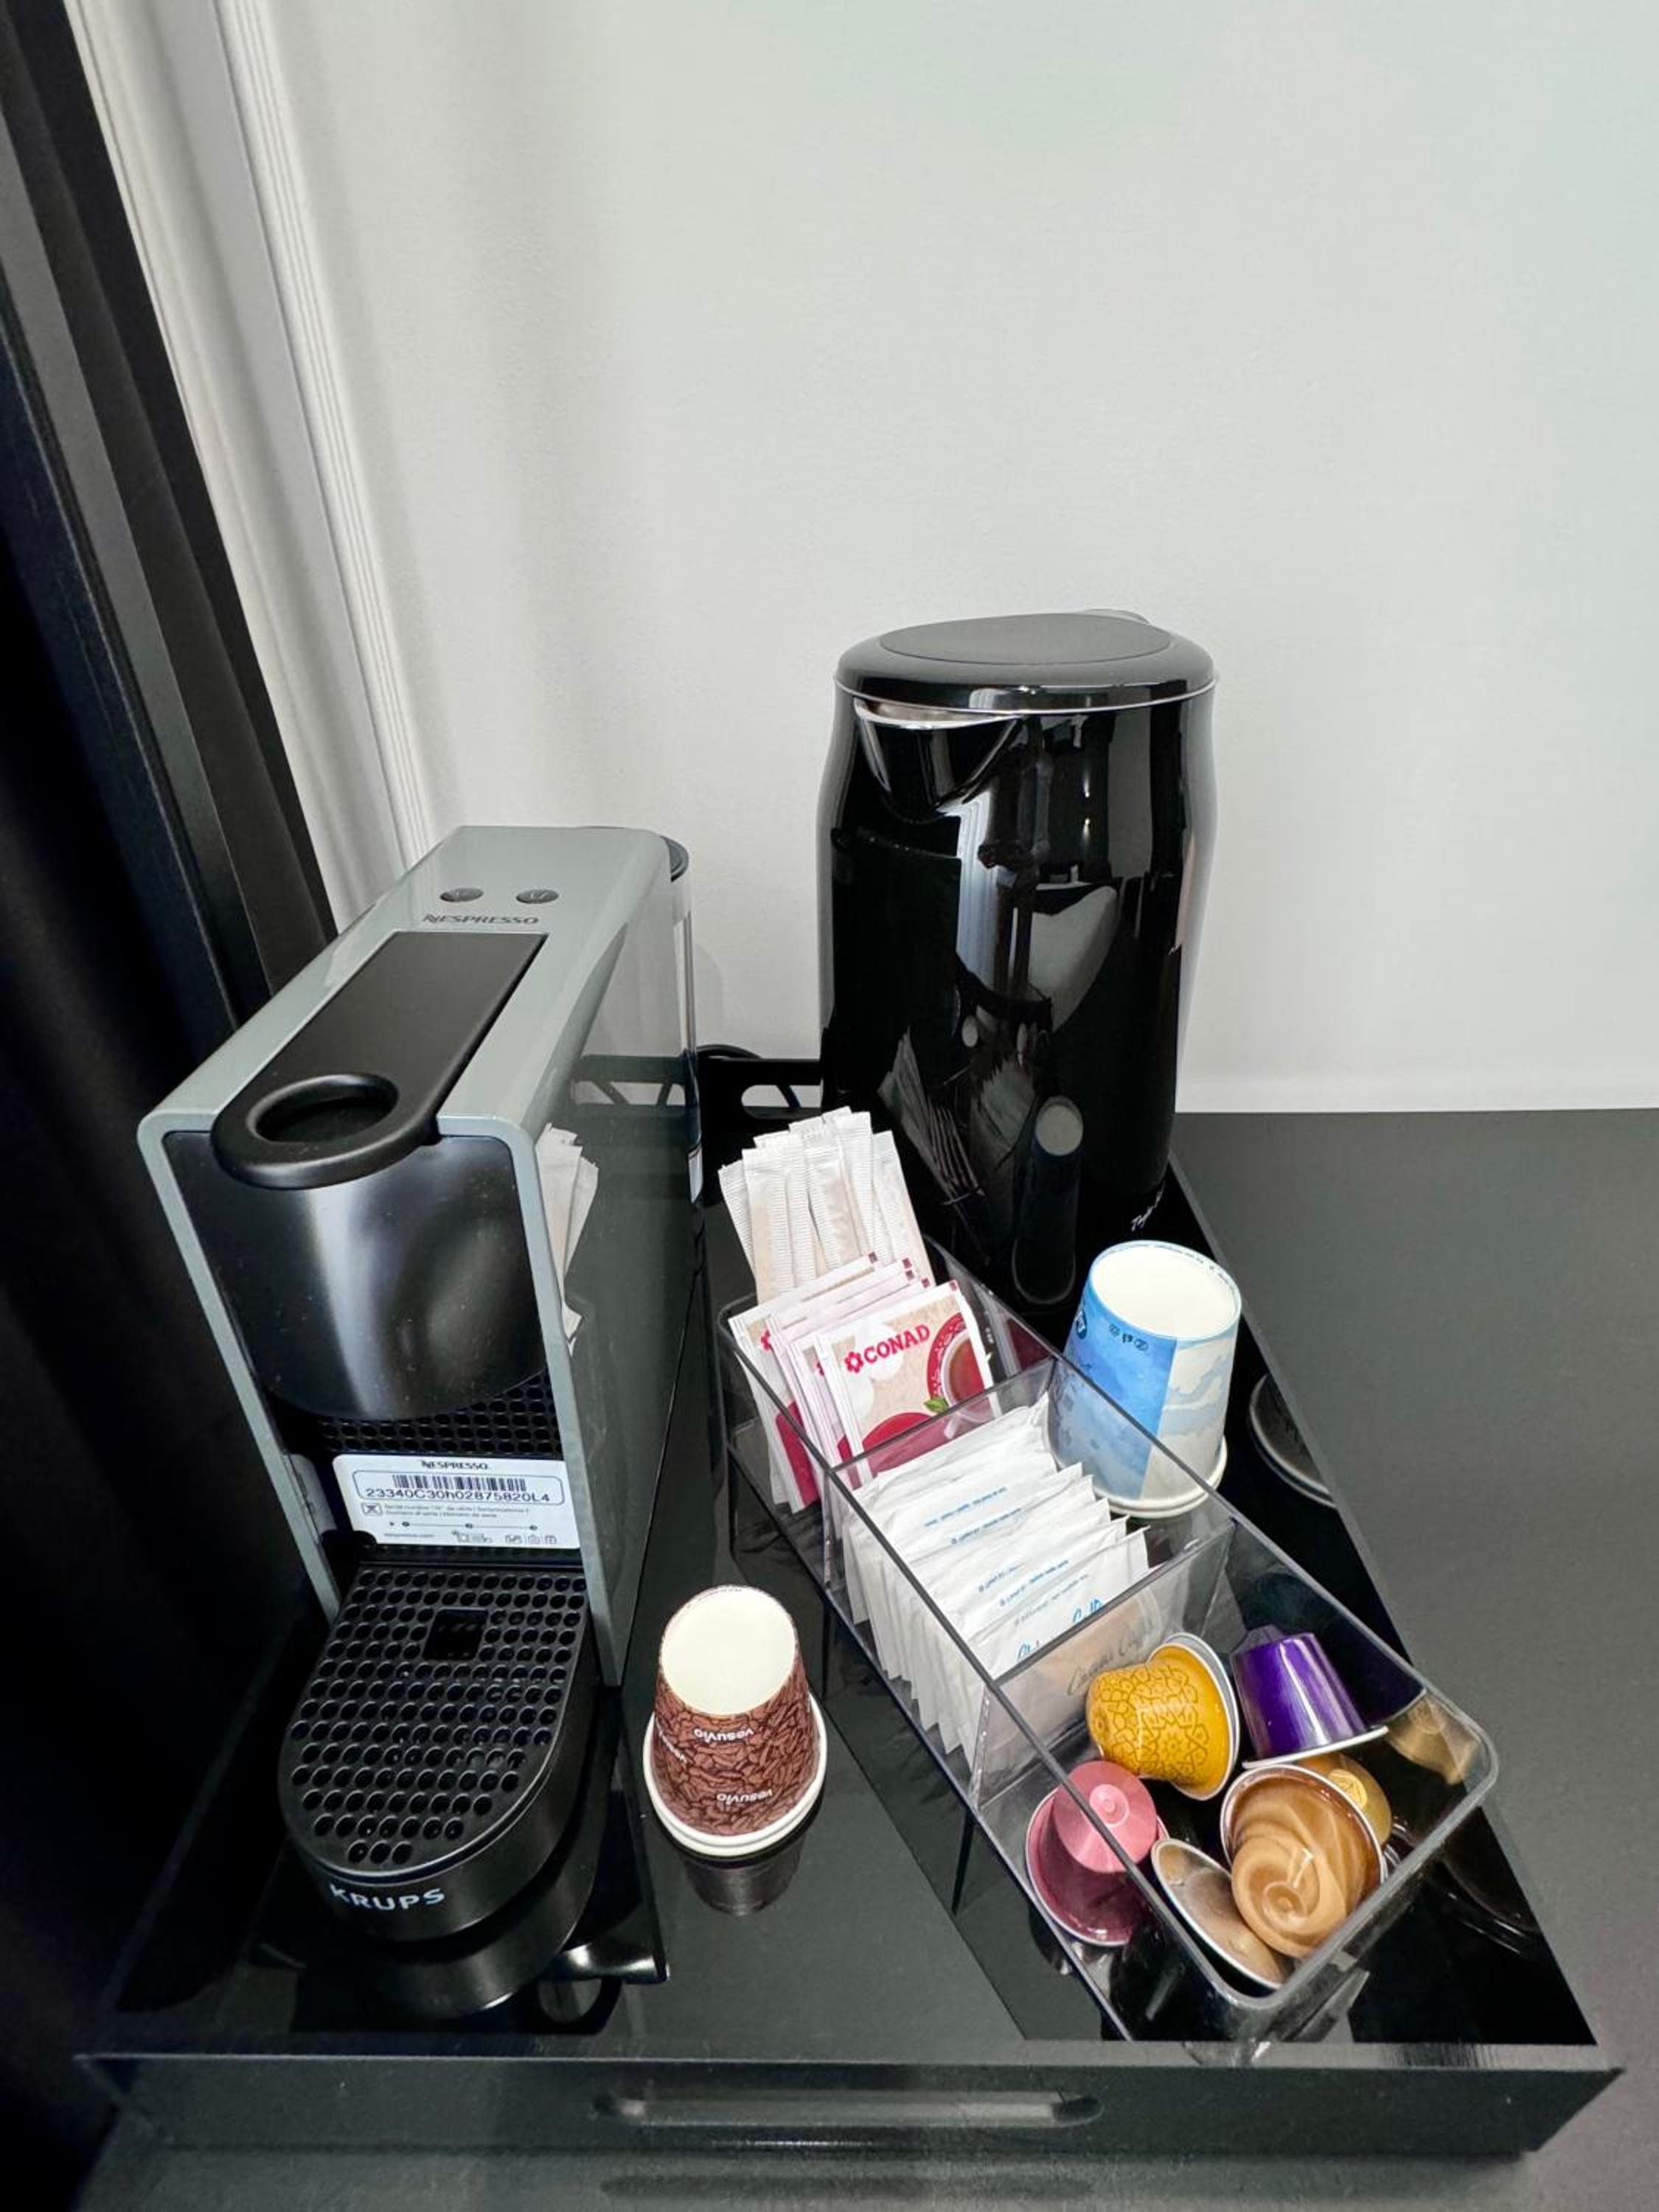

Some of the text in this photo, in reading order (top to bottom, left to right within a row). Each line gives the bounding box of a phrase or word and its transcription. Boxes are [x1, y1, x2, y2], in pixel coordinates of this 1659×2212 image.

[423, 914, 540, 925] NESPRESSO
[863, 1324, 931, 1364] CONAD
[421, 1459, 489, 1470] NESPRESSO
[330, 1883, 445, 1910] KRUPS
